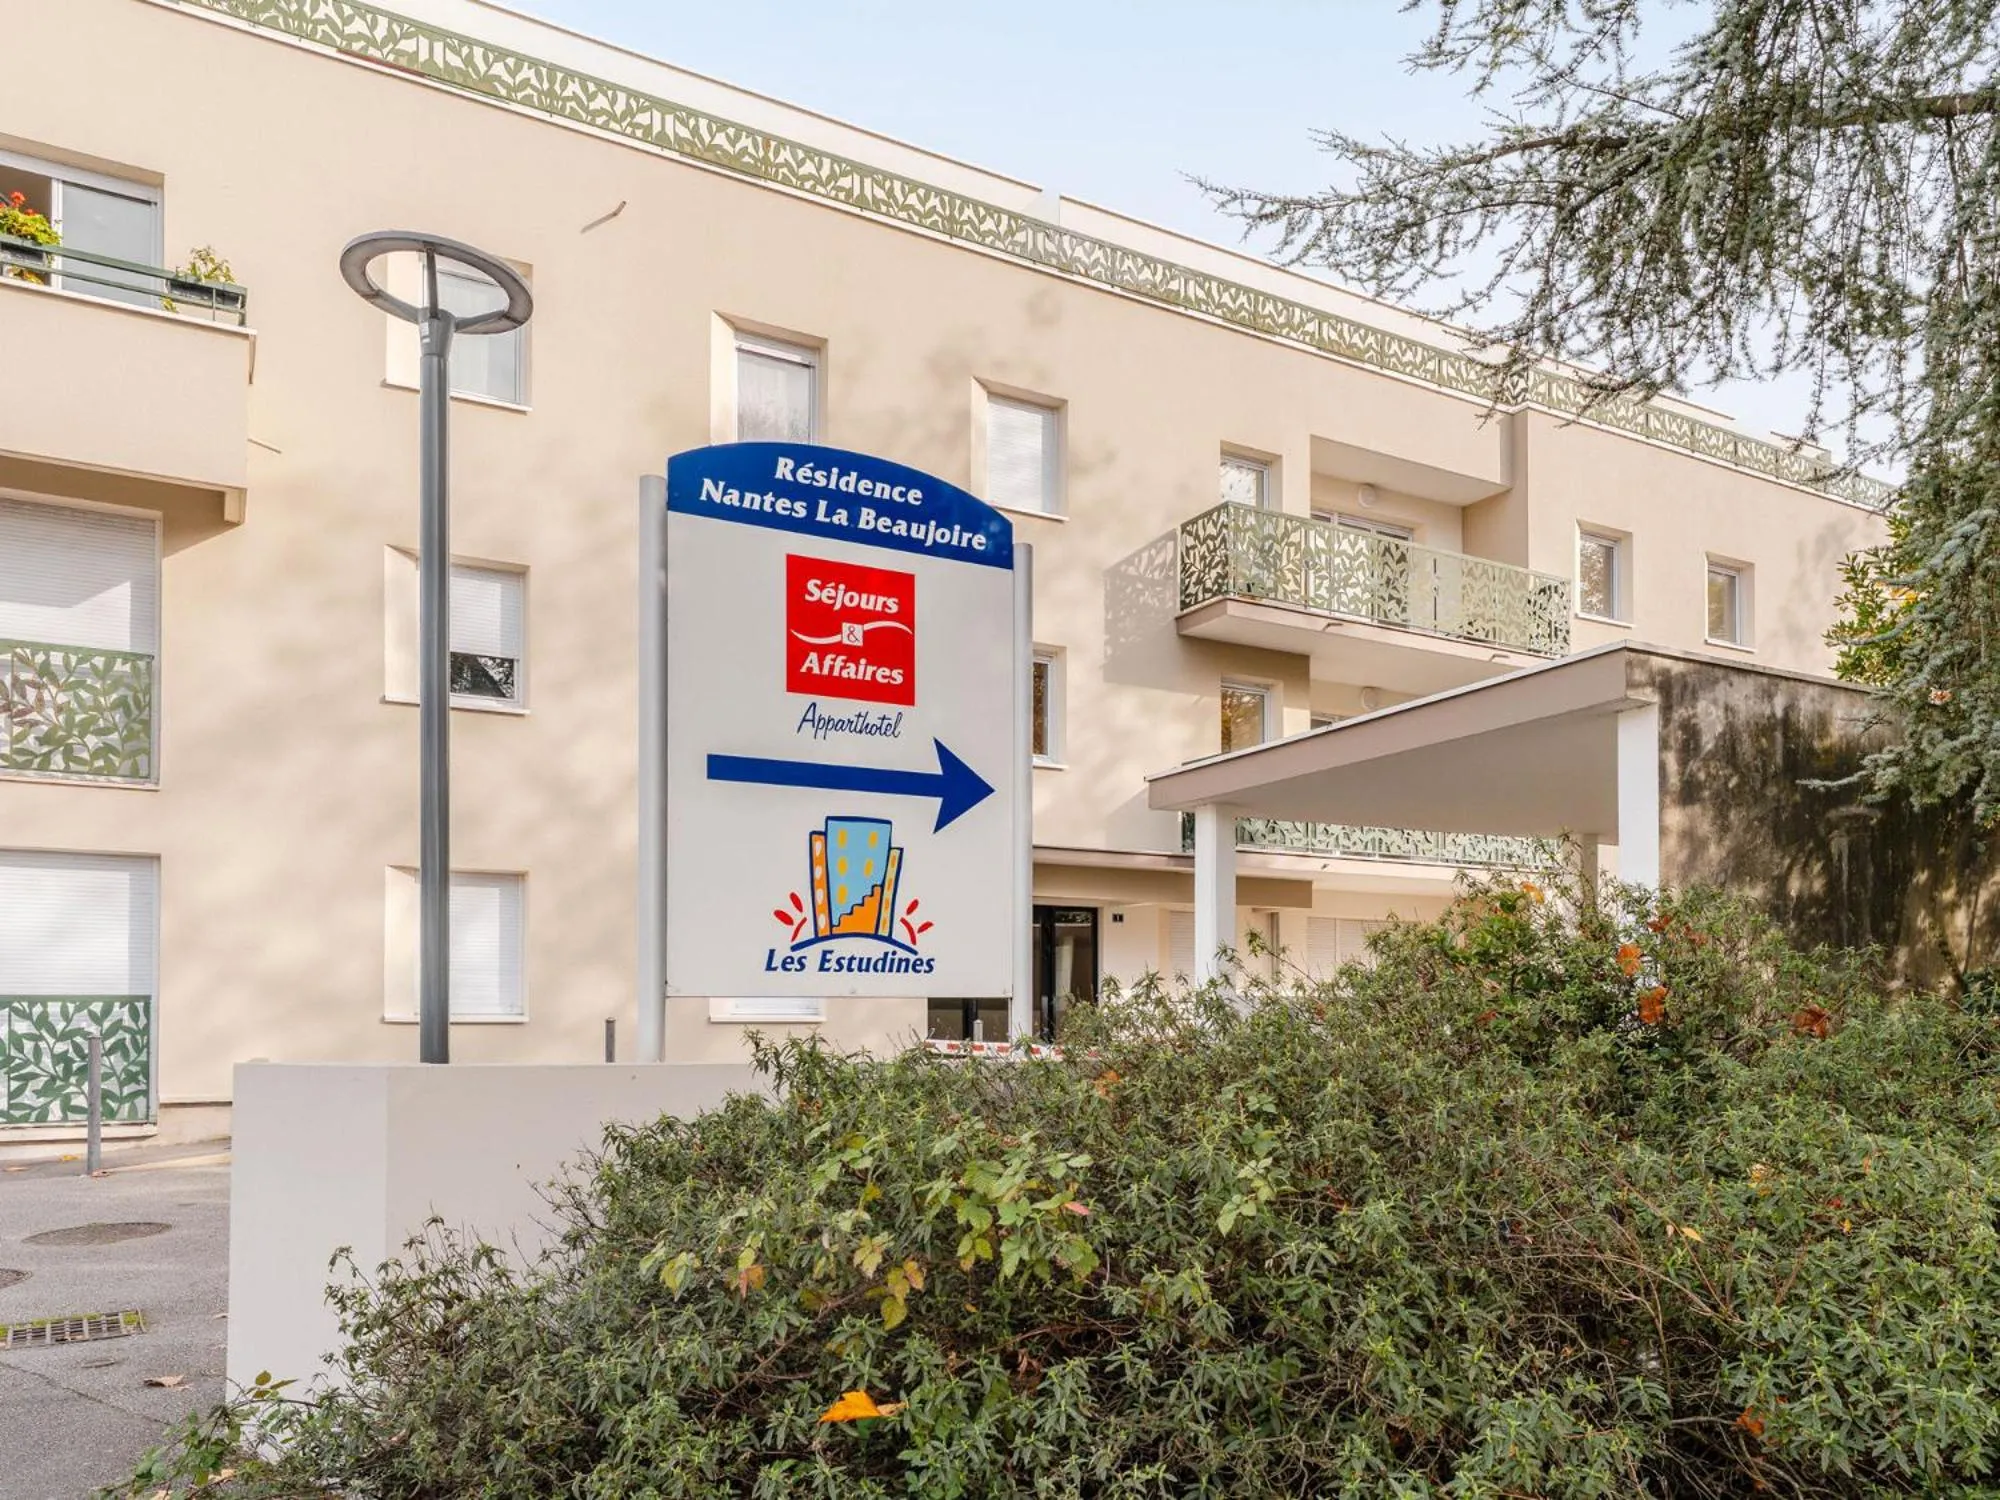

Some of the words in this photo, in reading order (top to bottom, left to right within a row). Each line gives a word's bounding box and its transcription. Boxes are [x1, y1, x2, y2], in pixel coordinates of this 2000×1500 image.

[775, 456, 923, 505] Résidence
[700, 478, 807, 518] Nantes
[816, 500, 849, 527] La
[858, 508, 987, 550] Beaujoire
[805, 578, 899, 614] Séjours
[848, 624, 859, 644] &
[800, 652, 904, 685] Affaires
[797, 702, 902, 740] Apparthotel
[765, 949, 806, 973] Les
[818, 950, 935, 974] Estudines
